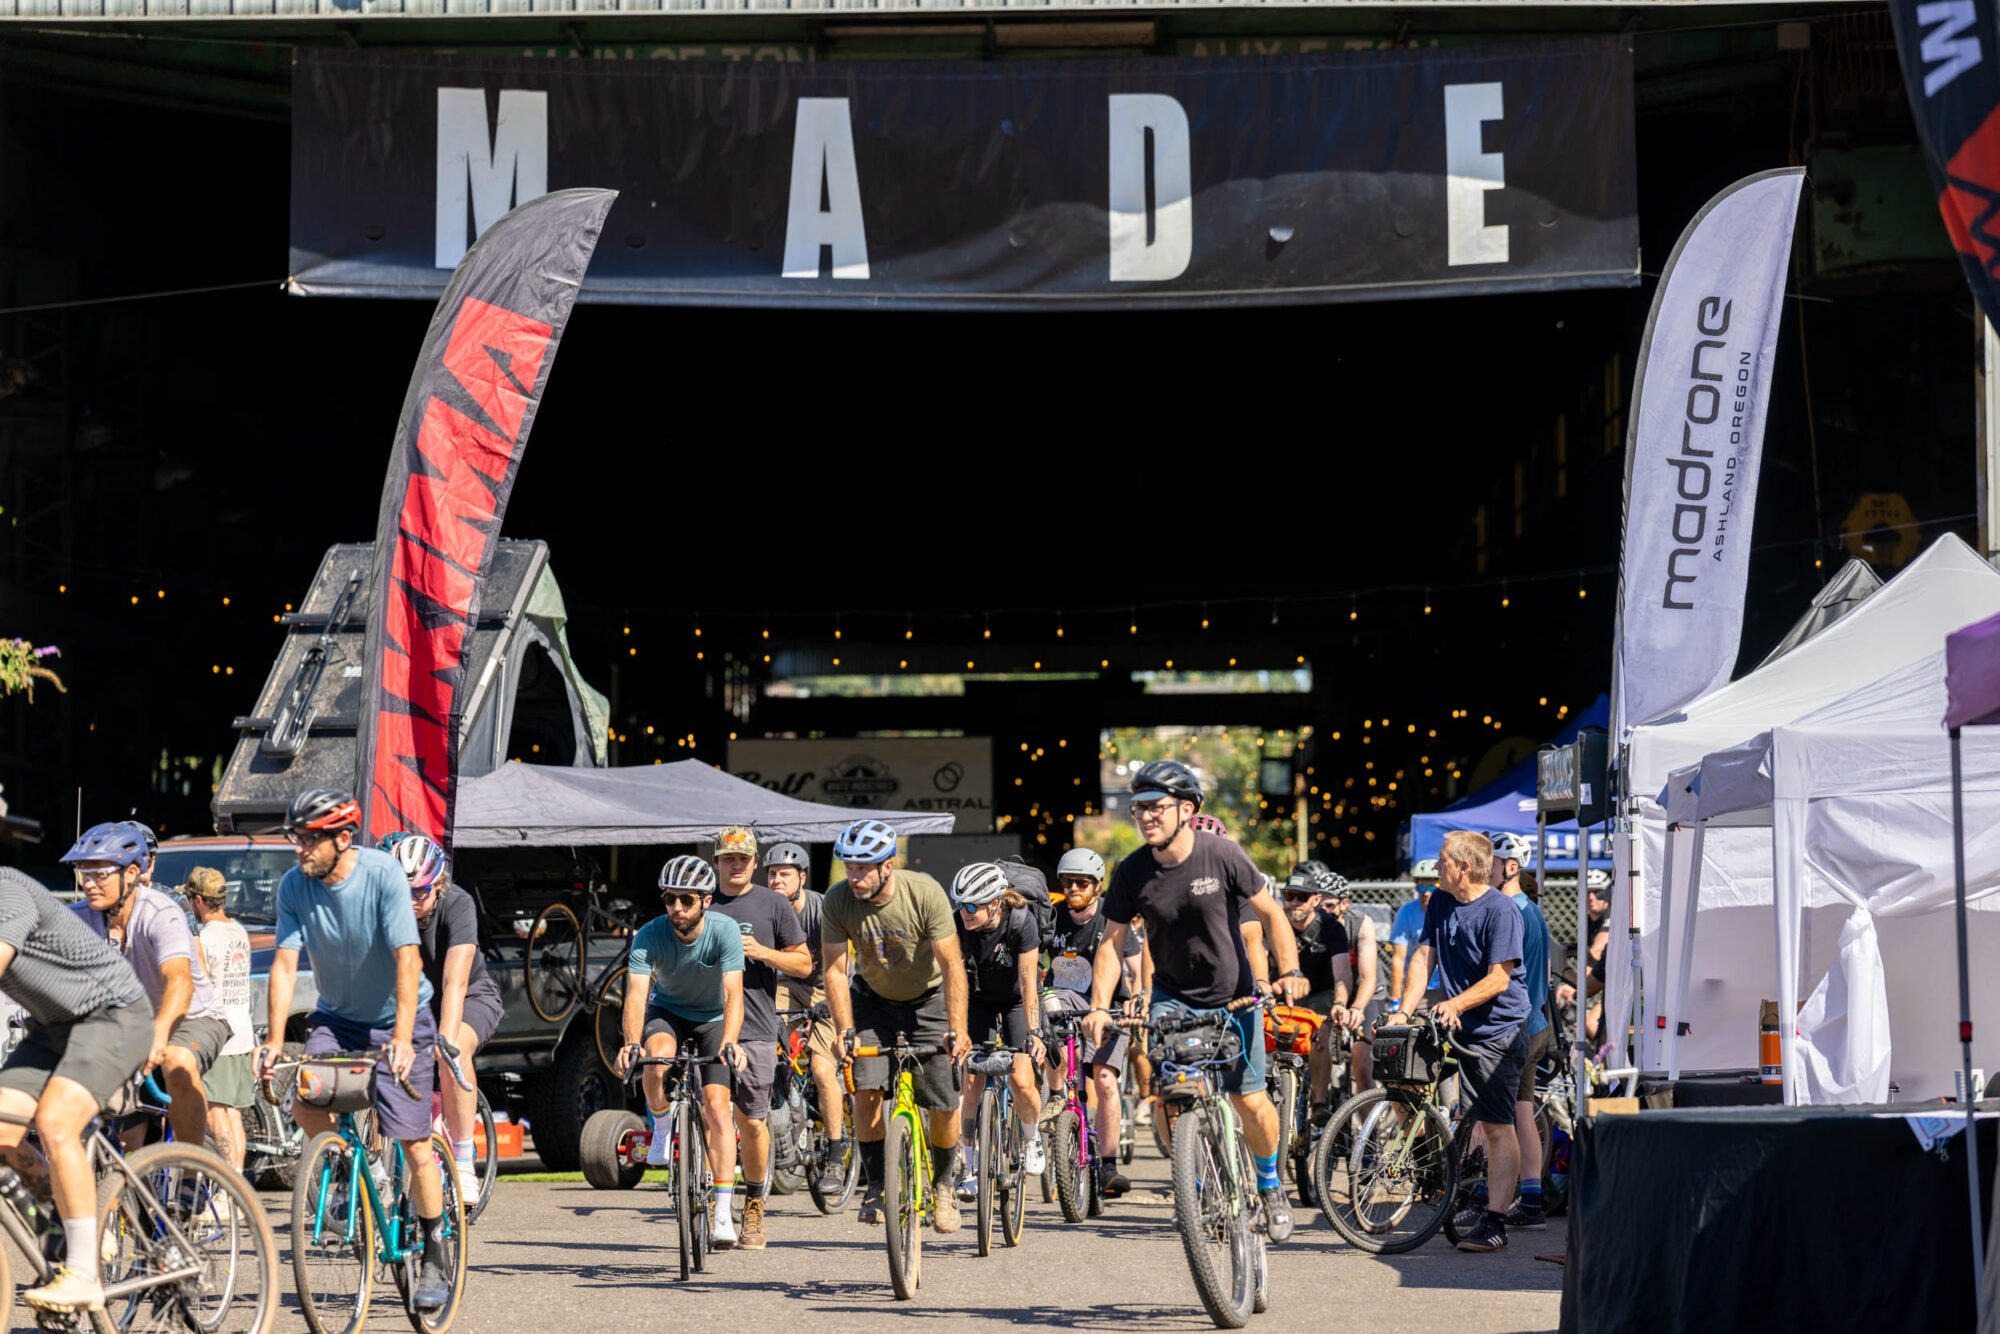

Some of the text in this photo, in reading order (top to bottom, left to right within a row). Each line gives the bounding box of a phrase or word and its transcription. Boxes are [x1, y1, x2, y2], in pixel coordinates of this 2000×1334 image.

[1662, 296, 1733, 610] madrone
[1713, 351, 1752, 562] ASHLAND OREGON
[902, 797, 991, 810] ASTRAL
